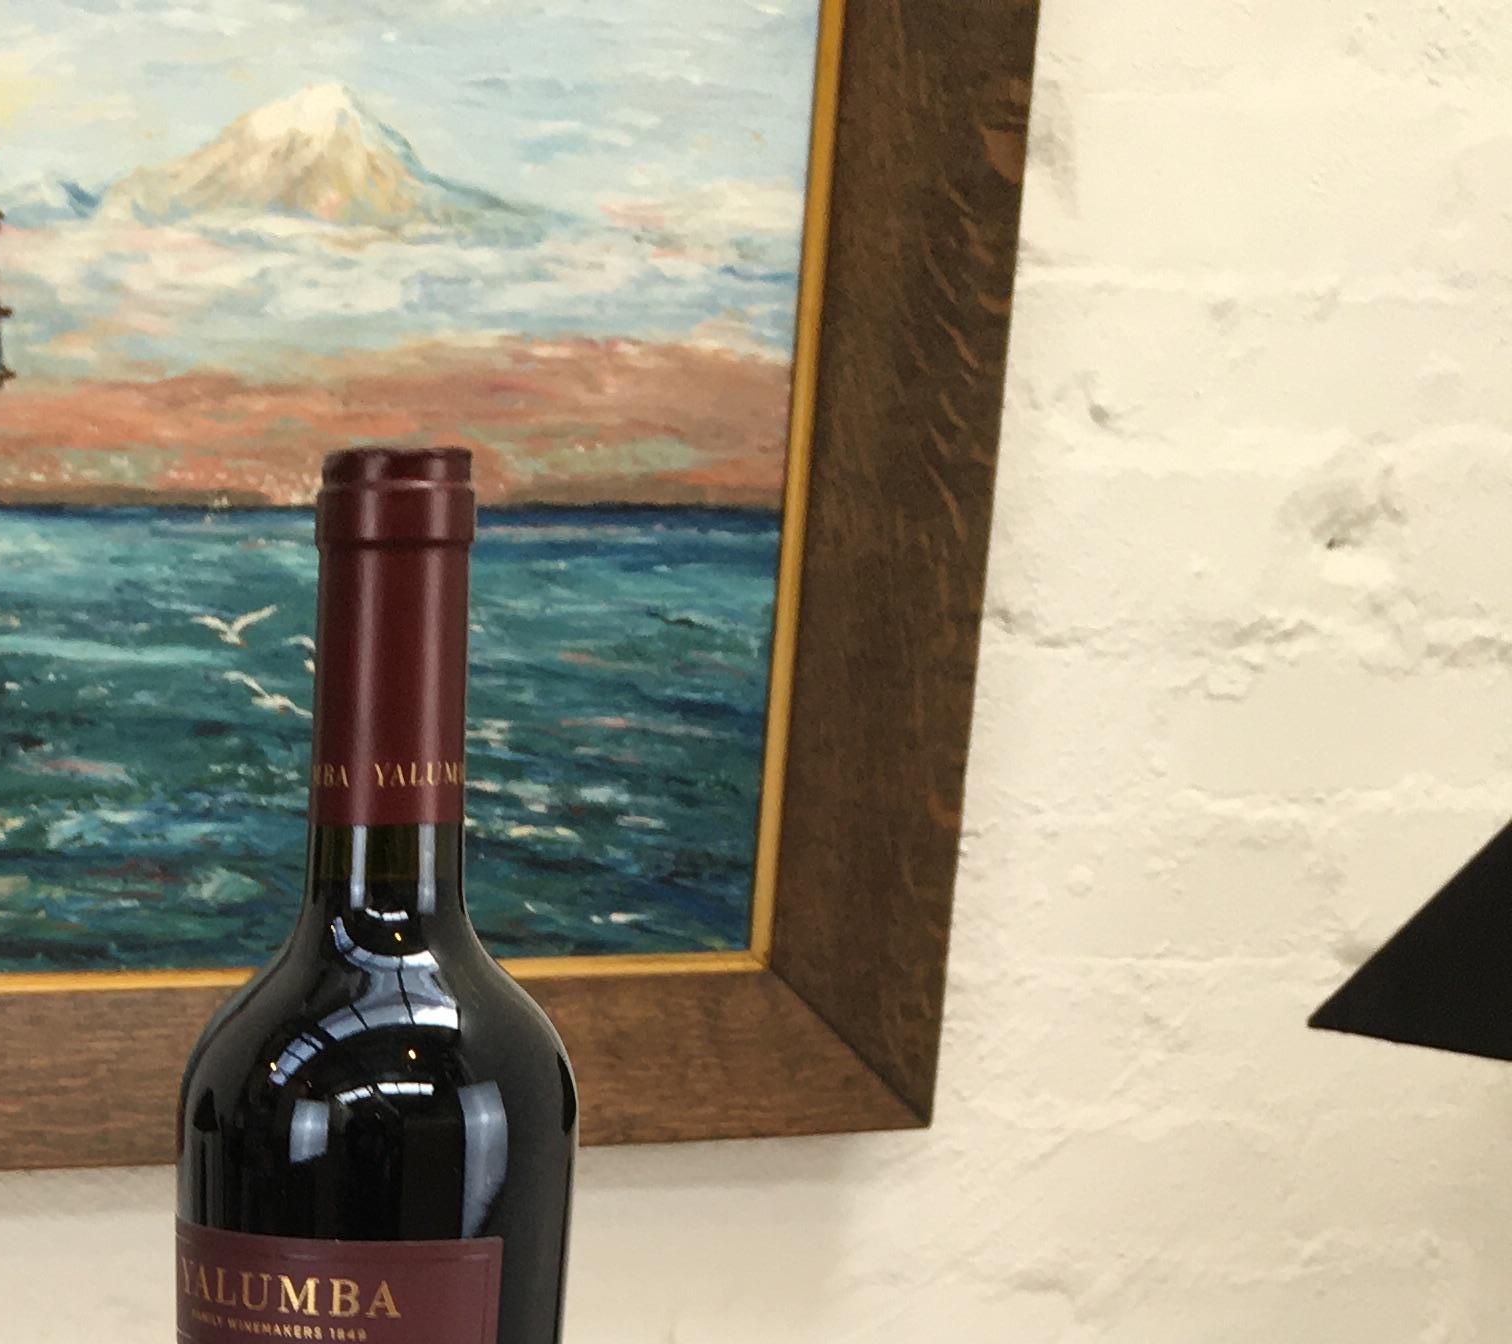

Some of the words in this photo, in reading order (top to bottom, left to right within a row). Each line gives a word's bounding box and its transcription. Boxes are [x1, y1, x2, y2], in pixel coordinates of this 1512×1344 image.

[181, 1256, 402, 1319] YALUMBA
[227, 1317, 324, 1341] WINEMAKERS
[328, 1327, 368, 1342] 1849
